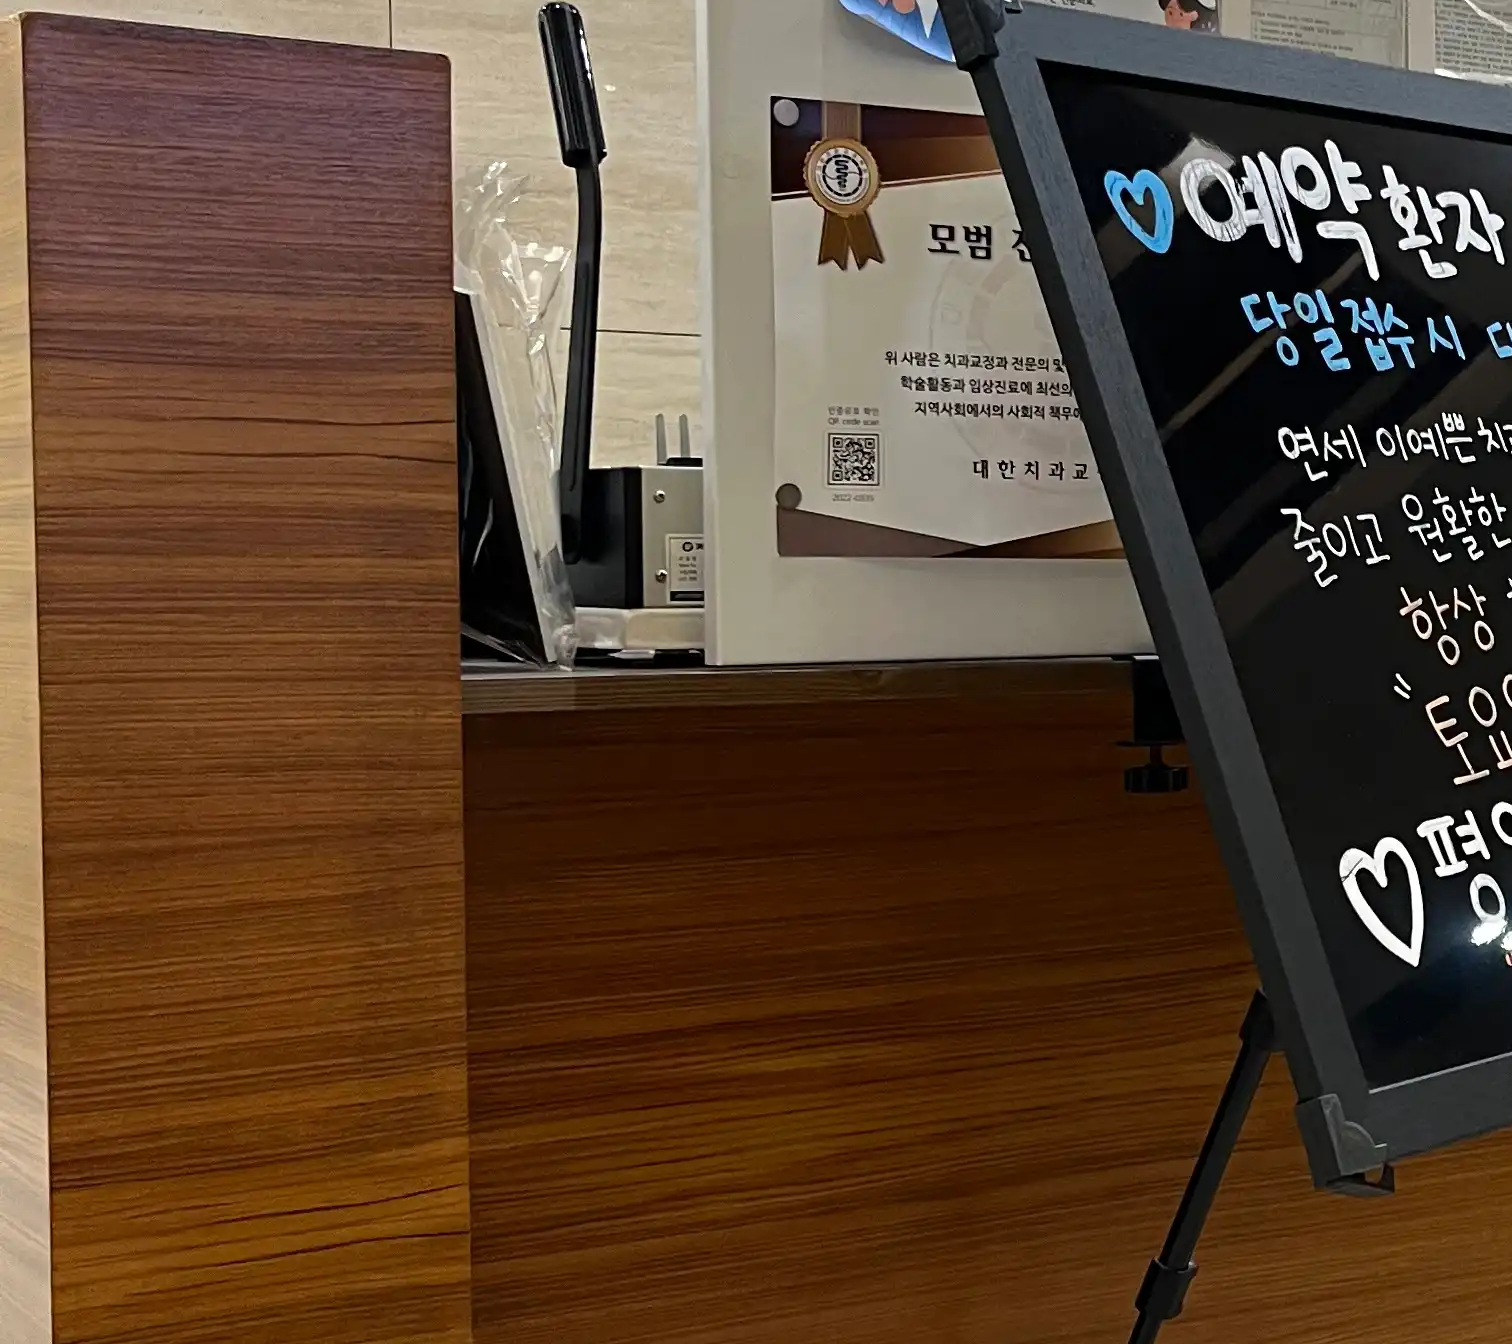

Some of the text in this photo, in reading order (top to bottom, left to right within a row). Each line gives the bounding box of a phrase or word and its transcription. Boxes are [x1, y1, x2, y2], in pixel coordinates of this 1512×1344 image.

[1180, 139, 1379, 281] 예약
[1380, 164, 1504, 278] 환자
[928, 224, 991, 259] 모범
[885, 350, 898, 366] 위
[901, 352, 940, 368] 사람은
[944, 353, 1008, 371] 치과교정과
[1011, 356, 1048, 371] 전문의
[901, 376, 965, 394] 학술활동과
[969, 379, 1032, 395] 임상진료에
[915, 403, 1004, 419] 지역사회에서의
[1007, 405, 1045, 420] 사회적
[973, 459, 1098, 480] 대한치과교
[1278, 426, 1365, 481] 연세
[1281, 508, 1390, 586] 줄이고
[1401, 486, 1512, 561] 원활한
[1400, 585, 1495, 665] 항상
